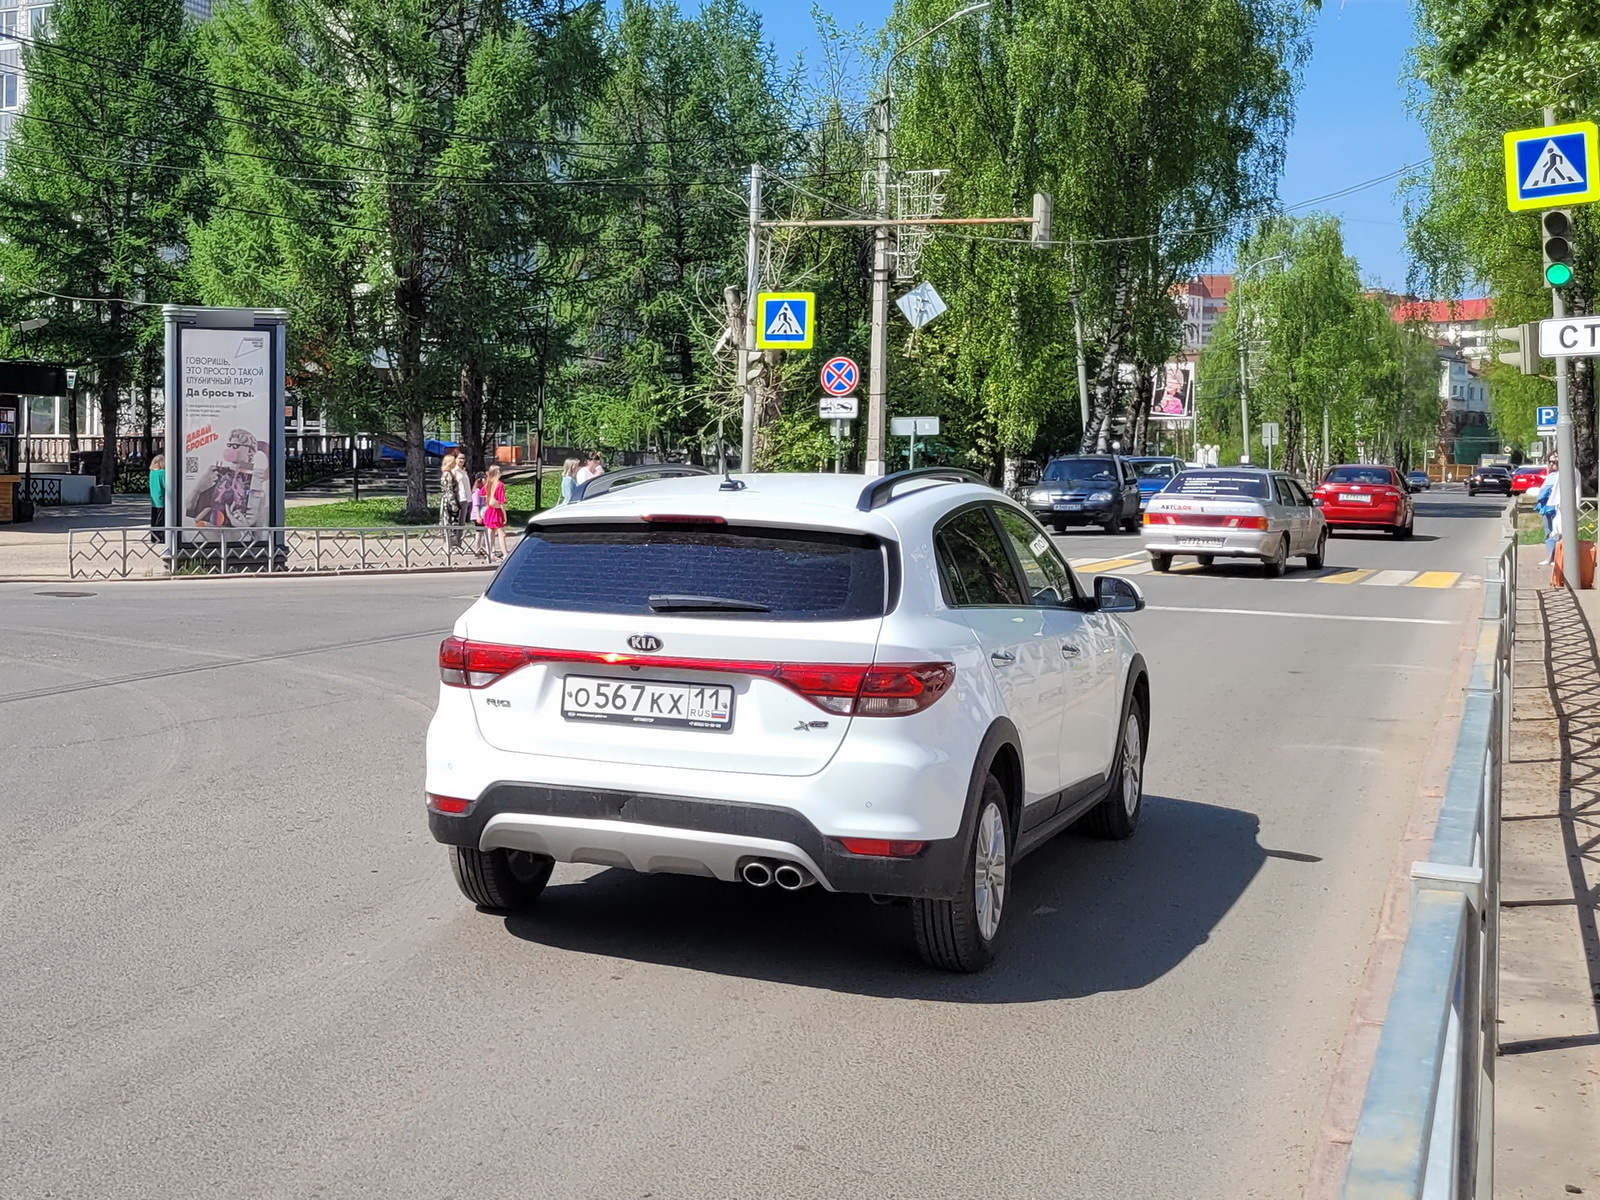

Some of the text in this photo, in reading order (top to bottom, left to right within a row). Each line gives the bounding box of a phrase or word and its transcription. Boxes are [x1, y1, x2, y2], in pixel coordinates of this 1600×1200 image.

[186, 356, 231, 366] ГОВОРИШЬ,
[186, 366, 264, 376] ЭТО ПРОСТО ТАКОЙ
[234, 377, 254, 386] ПАР?
[186, 388, 254, 399] Да брось ты.
[186, 423, 212, 445] ДАВАЙ
[186, 432, 219, 454] БРОСАТЬ
[631, 636, 657, 649] KIA
[693, 688, 720, 710] 11
[690, 710, 711, 718] RUS
